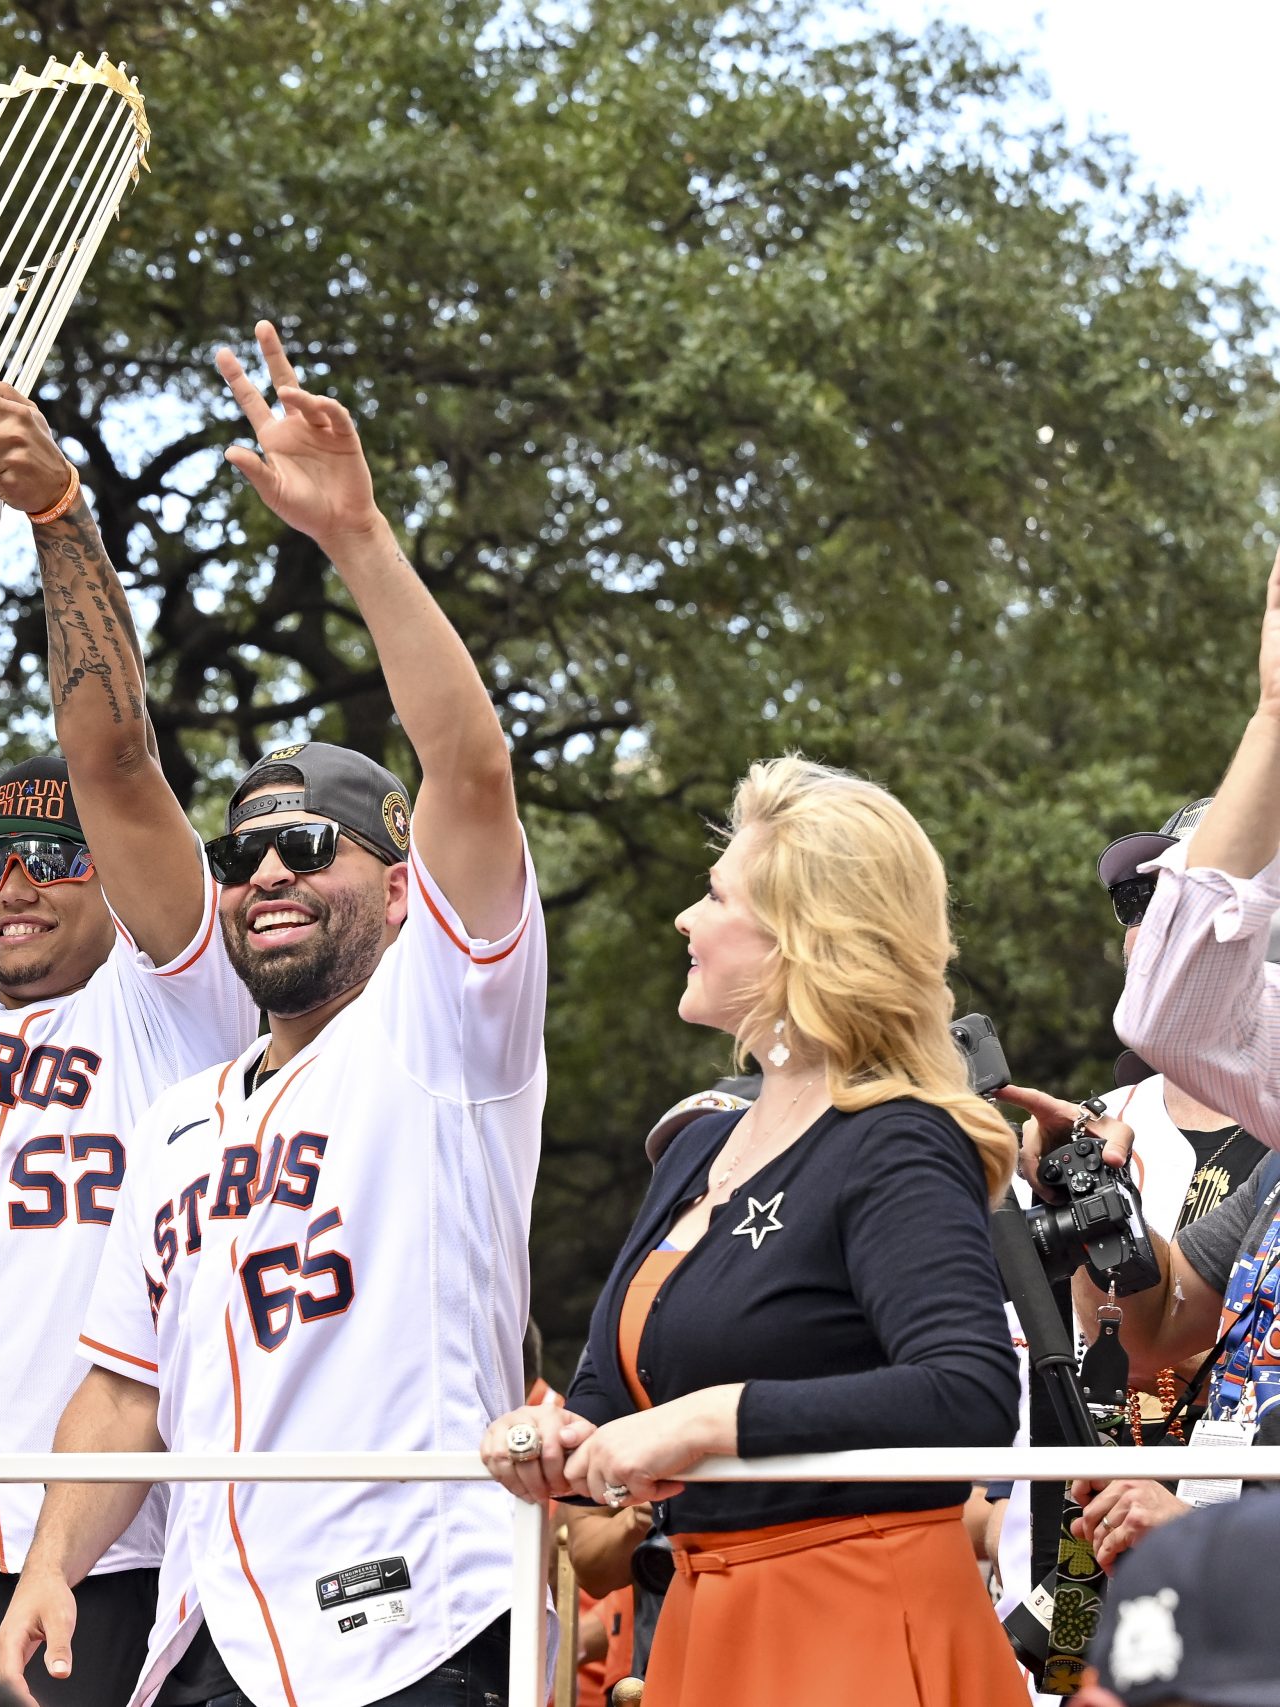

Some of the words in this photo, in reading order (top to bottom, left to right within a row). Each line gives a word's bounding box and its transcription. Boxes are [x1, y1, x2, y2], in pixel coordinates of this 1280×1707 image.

[34, 779, 68, 798] UN
[8, 1132, 128, 1230] 52
[238, 1205, 356, 1354] 65
